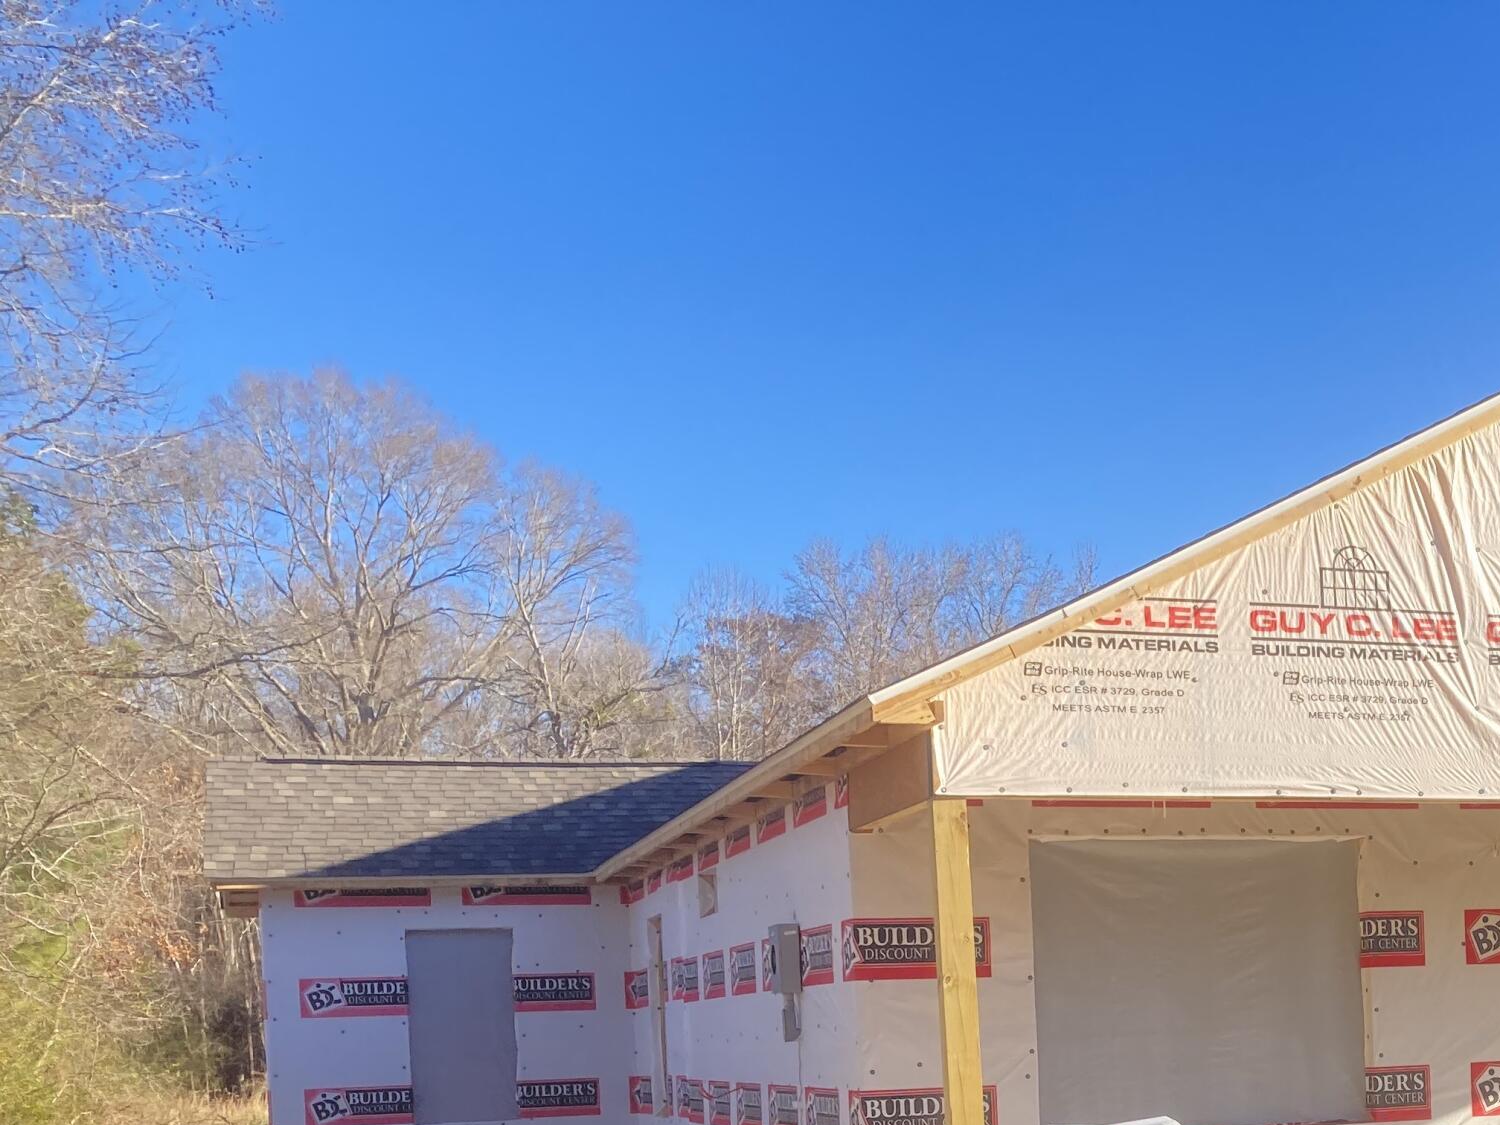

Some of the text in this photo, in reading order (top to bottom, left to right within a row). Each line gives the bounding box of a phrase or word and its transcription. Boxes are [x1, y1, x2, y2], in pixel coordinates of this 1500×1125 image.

[1144, 605, 1217, 629] LEE
[1250, 609, 1457, 641] GUY C. LEE
[1098, 637, 1219, 653] MATERIALS
[1251, 644, 1460, 664] BUILDING MATERIALS
[1044, 665, 1191, 680] Grip-Rite House-Wrap LWE
[1302, 675, 1434, 689] Grip-Rite House-Wrap LWE
[1051, 685, 1070, 694] ICC
[1074, 685, 1098, 694] ESR
[1110, 686, 1138, 697] 3729,
[1141, 688, 1173, 697] Grade
[1177, 688, 1185, 697] D
[1308, 693, 1325, 702] ICC
[1328, 693, 1349, 703] ESR
[1389, 695, 1418, 706] Grade
[1421, 696, 1429, 705] D
[1052, 703, 1165, 714] MEETS ASTM E 2357
[1308, 711, 1344, 720] MEETS
[1347, 712, 1375, 721] ASTM
[1378, 937, 1419, 951] CENTER
[864, 947, 931, 961] DISCOUNT
[1384, 1092, 1424, 1104] CENTER
